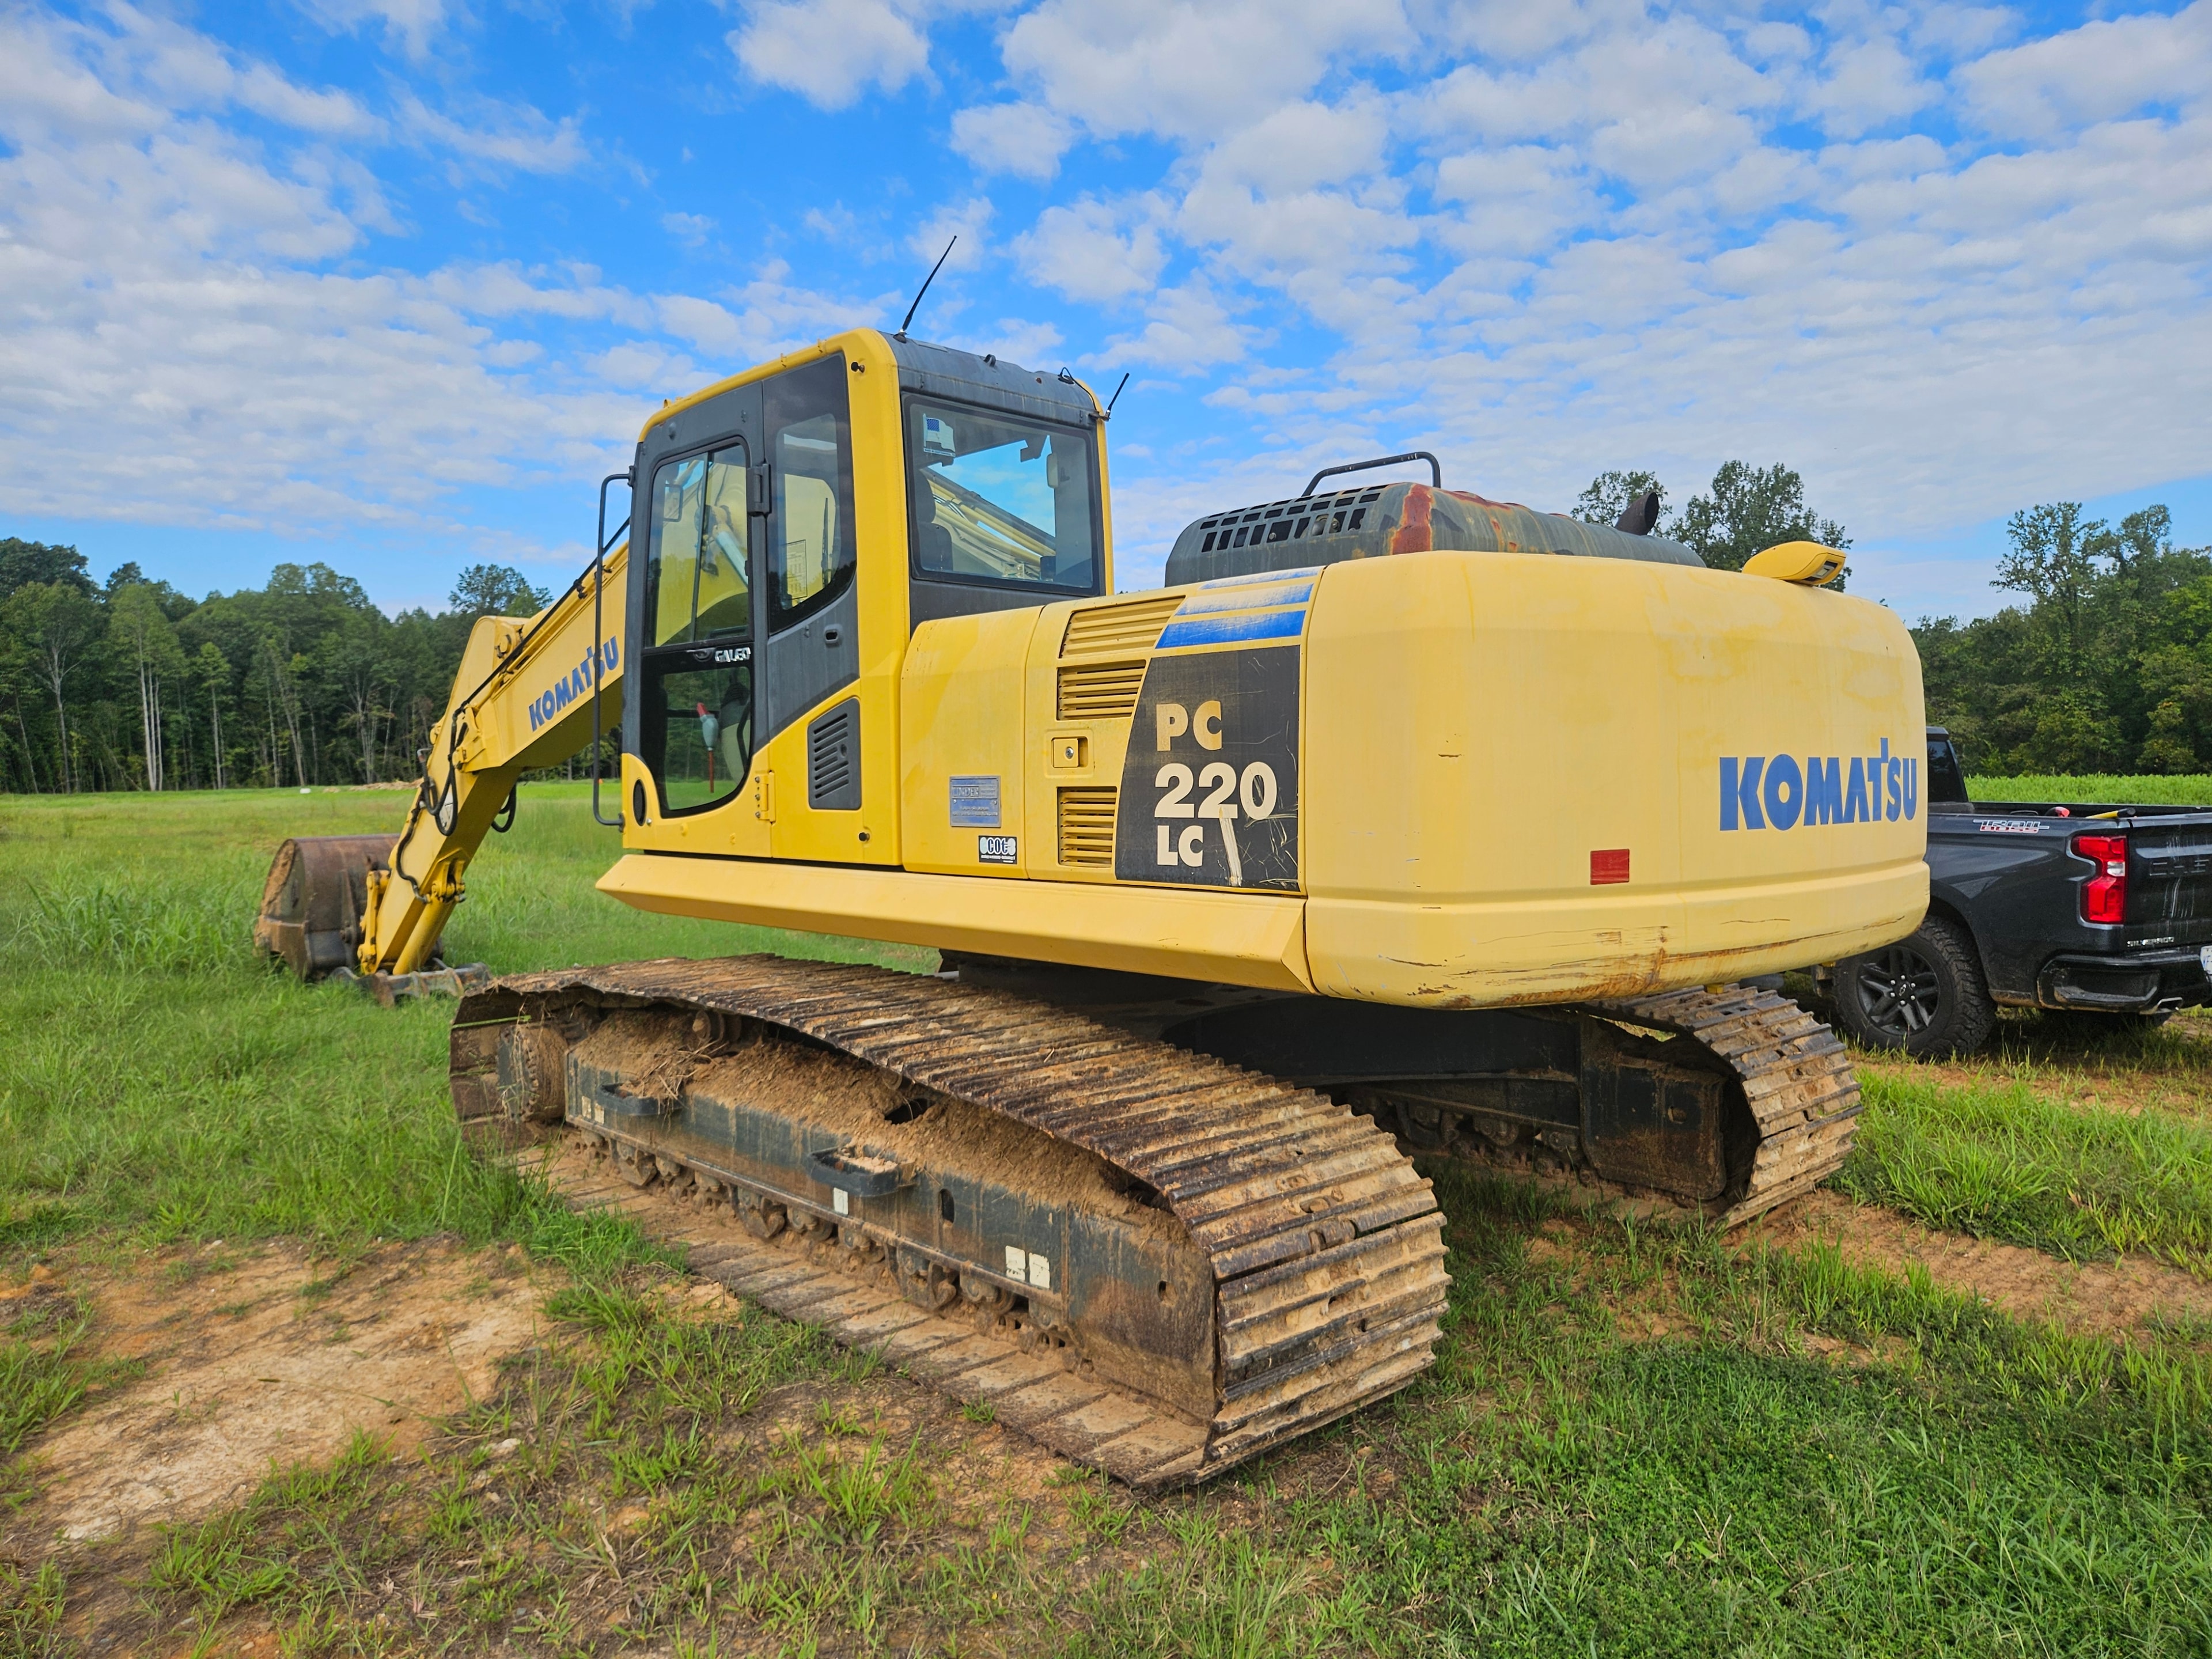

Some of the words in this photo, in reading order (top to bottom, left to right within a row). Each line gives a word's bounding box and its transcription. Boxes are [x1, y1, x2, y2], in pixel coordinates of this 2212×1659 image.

[1156, 700, 1222, 751] PC
[1154, 762, 1277, 820] 220
[1719, 737, 1916, 831] KOMATSU
[1157, 825, 1203, 868] LC
